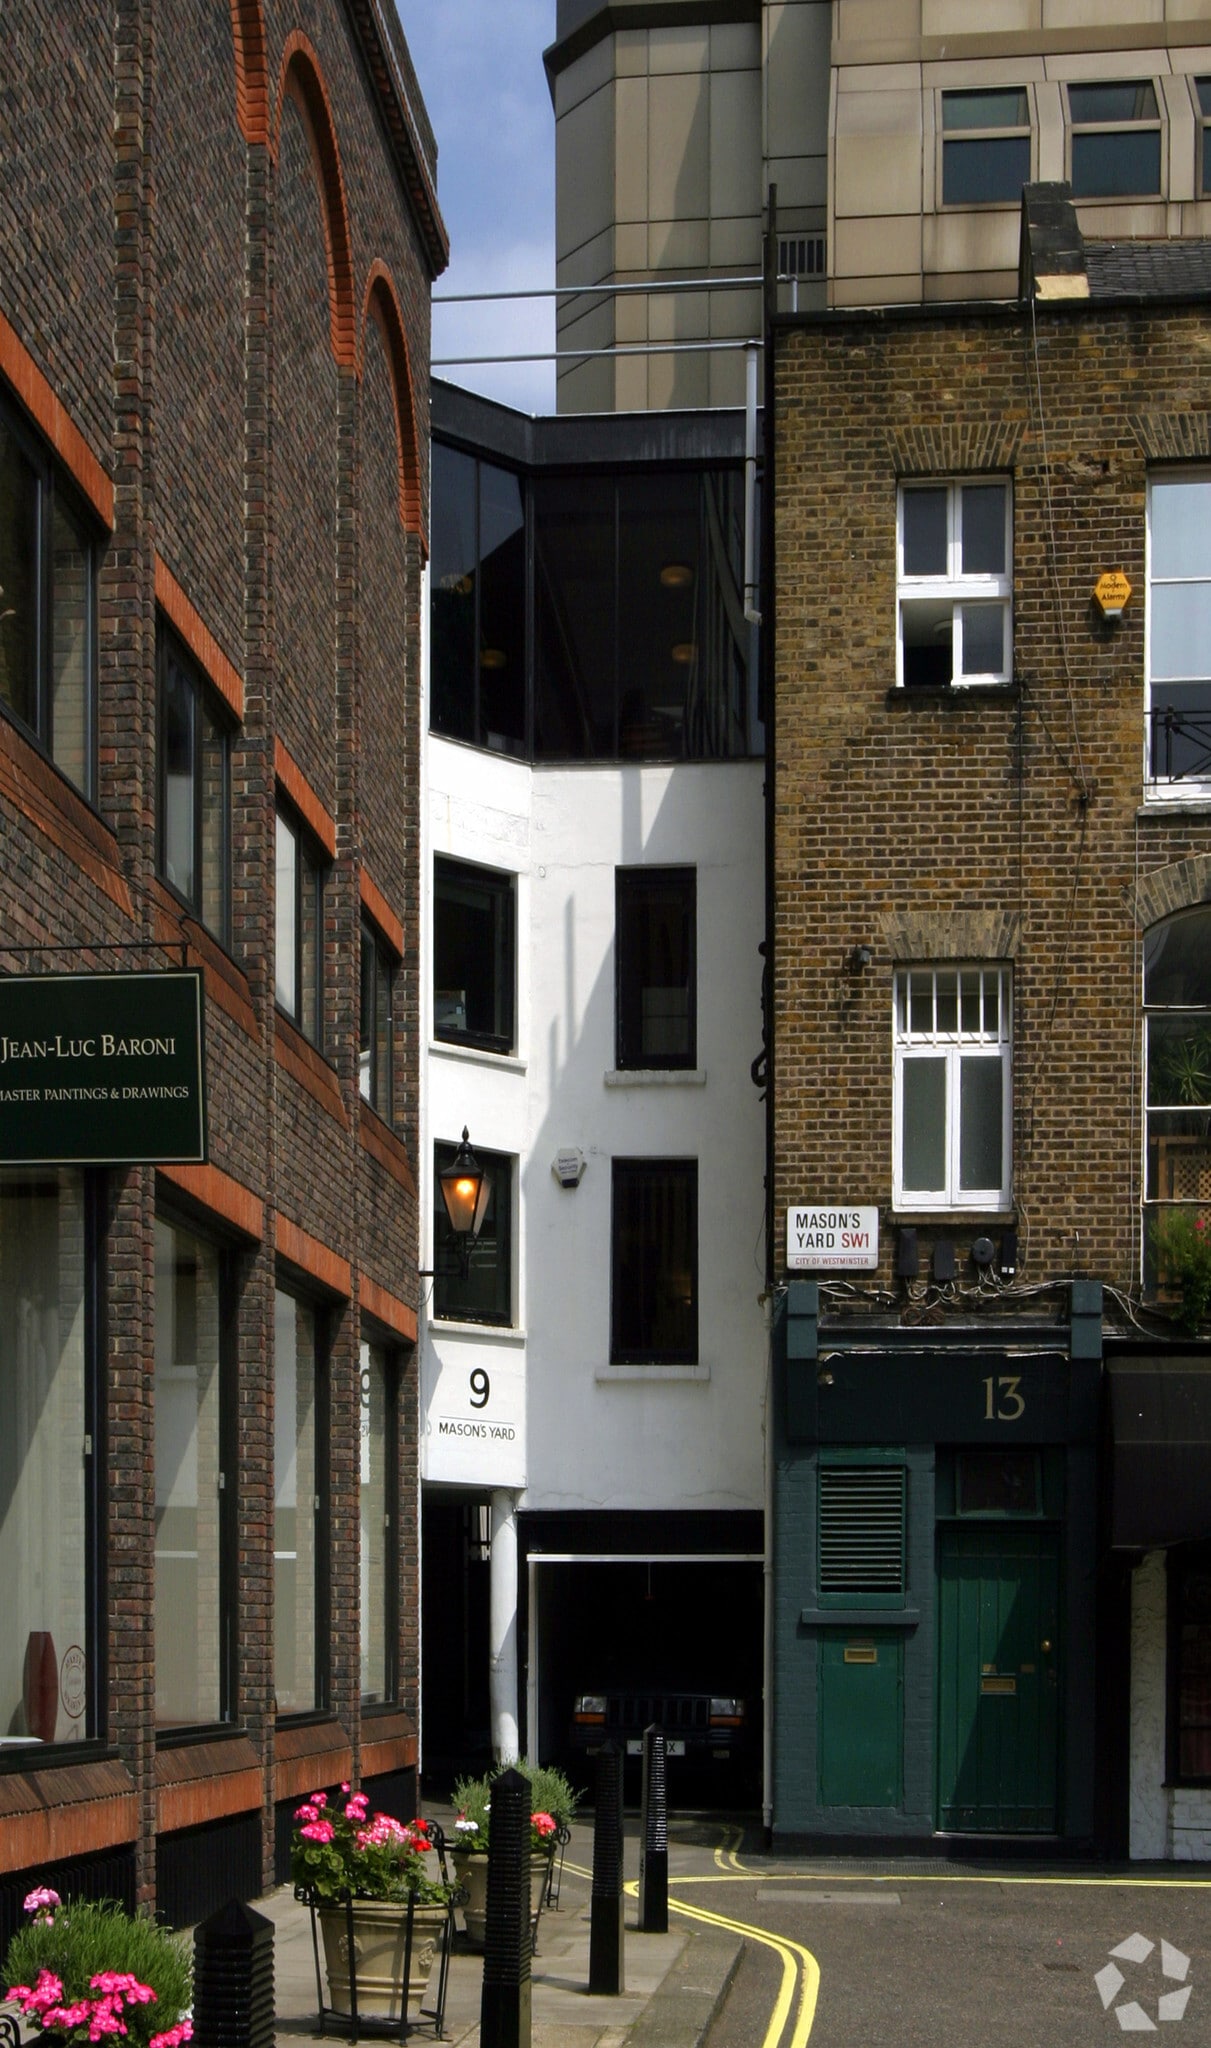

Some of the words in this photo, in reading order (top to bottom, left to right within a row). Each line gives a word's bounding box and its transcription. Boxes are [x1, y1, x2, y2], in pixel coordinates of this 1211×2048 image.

[1, 1035, 96, 1064] JEAN-LUC
[101, 1034, 177, 1057] BARONI
[44, 1087, 109, 1101] PAINTINGS
[110, 1087, 120, 1100] &
[122, 1086, 190, 1100] DRAWINGS
[795, 1213, 861, 1229] MASON'S
[796, 1233, 836, 1249] YARD
[841, 1232, 870, 1249] SW1
[795, 1257, 810, 1265] CITY
[811, 1257, 821, 1265] OF
[822, 1257, 869, 1265] WESTMINSTER
[469, 1367, 490, 1410] 9
[982, 1376, 1026, 1421] 13
[438, 1421, 487, 1439] MASON'S
[488, 1426, 516, 1441] YARD
